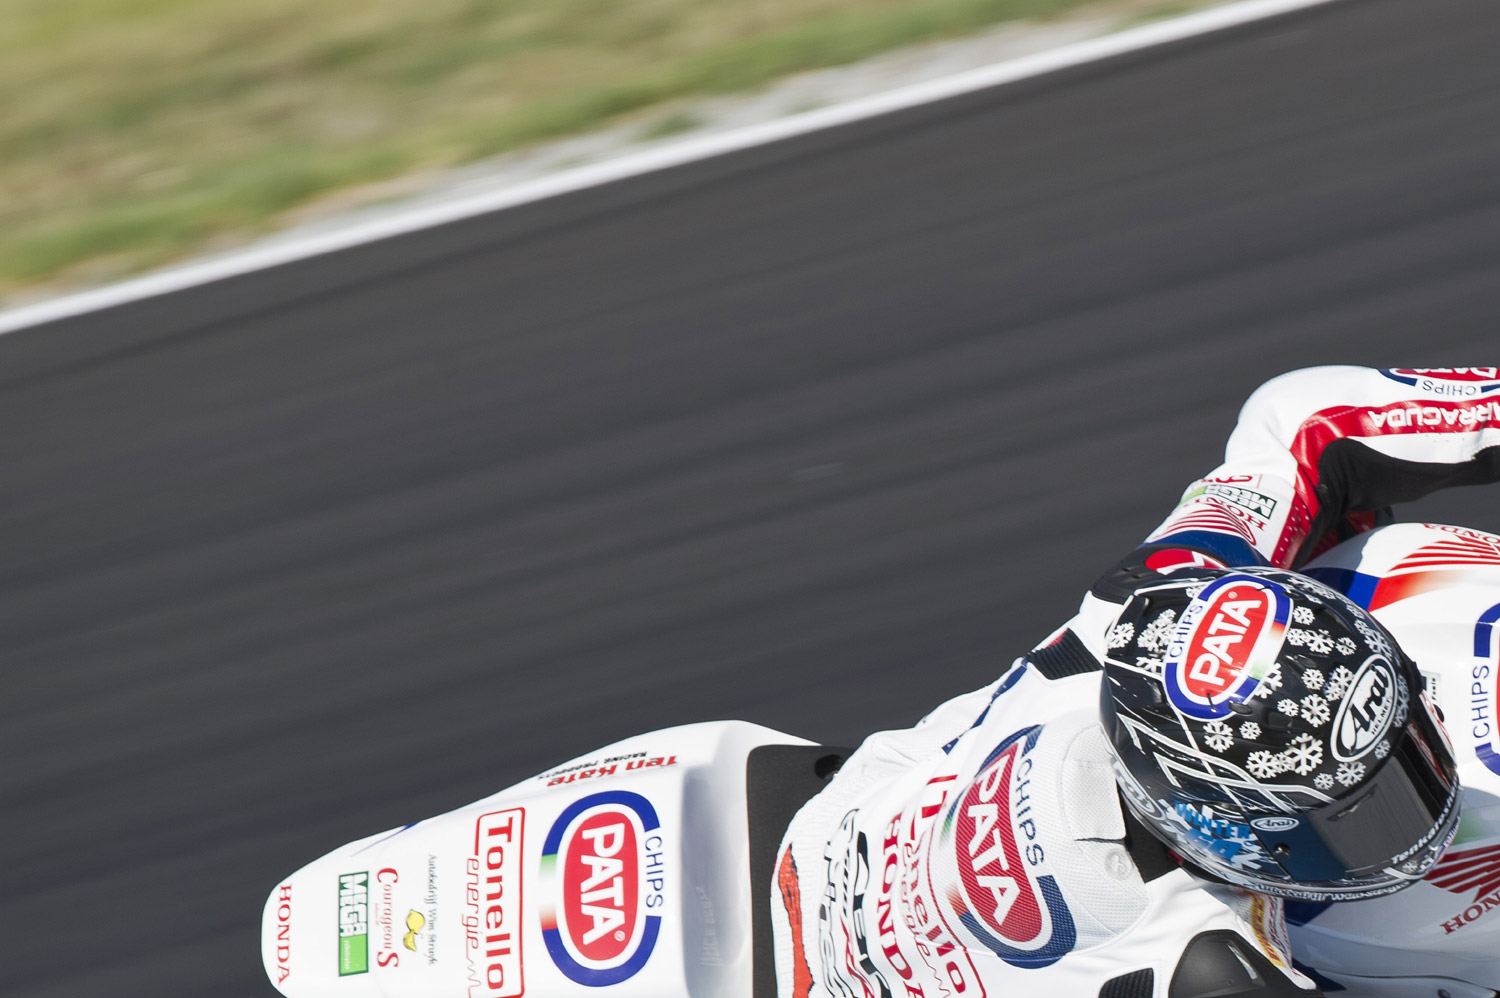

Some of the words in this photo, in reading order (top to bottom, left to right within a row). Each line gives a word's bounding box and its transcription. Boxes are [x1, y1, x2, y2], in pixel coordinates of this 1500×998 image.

[1423, 380, 1476, 396] CHIPS
[1183, 497, 1267, 532] HON
[1170, 603, 1204, 659] CHIPS
[1189, 598, 1262, 687] PATA
[1344, 665, 1389, 741] Arai
[1473, 664, 1489, 738] CHIPS
[547, 764, 618, 787] Kate
[625, 756, 677, 771] Ten
[967, 752, 1022, 925] PATA
[1016, 759, 1044, 867] CHIPS
[1174, 800, 1251, 840] WINTER
[461, 857, 483, 950] energie
[486, 817, 513, 990] Tonello
[580, 822, 626, 946] PATA
[645, 835, 664, 909] CHIPS
[277, 884, 292, 986] HONDA
